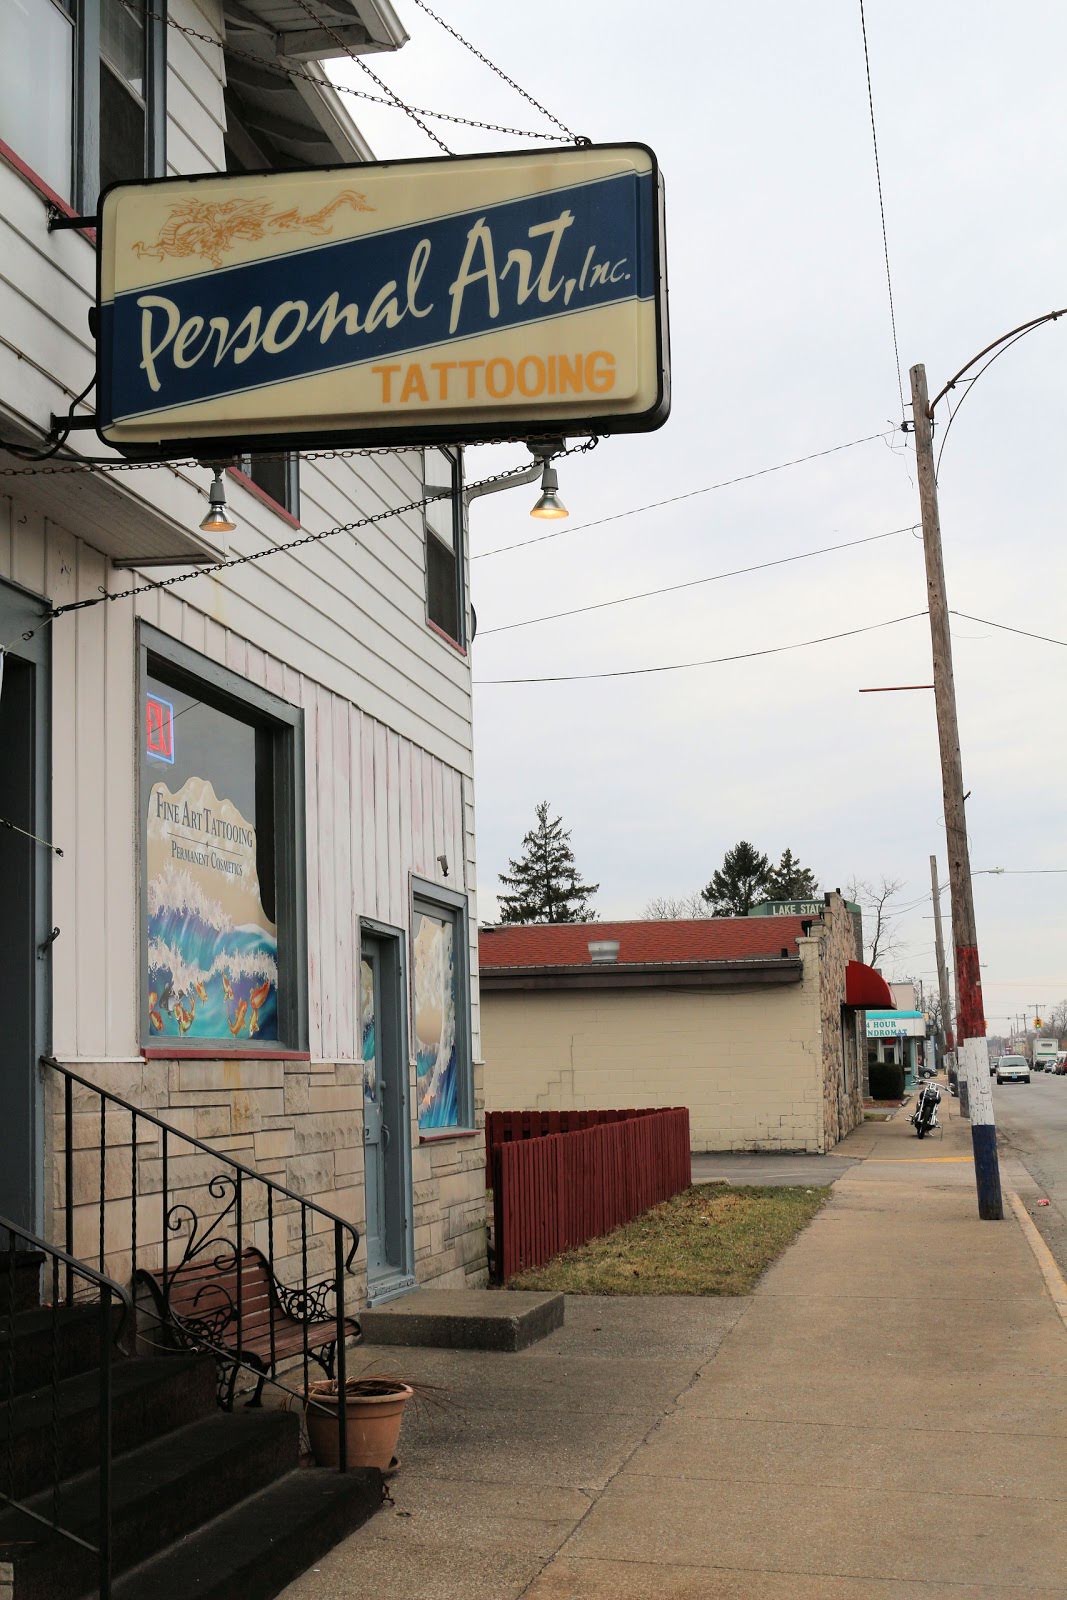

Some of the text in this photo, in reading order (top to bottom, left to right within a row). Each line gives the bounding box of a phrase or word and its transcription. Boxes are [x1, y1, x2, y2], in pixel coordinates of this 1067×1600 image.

[136, 238, 433, 392] Personal
[578, 245, 631, 291] Inc.
[371, 351, 616, 404] TATTOOING
[156, 791, 253, 848] FINE ART TATTOOING
[171, 840, 243, 876] PERMANENT COSMETICS
[772, 903, 826, 915] LAKE STAT
[873, 1020, 897, 1028] HOUR
